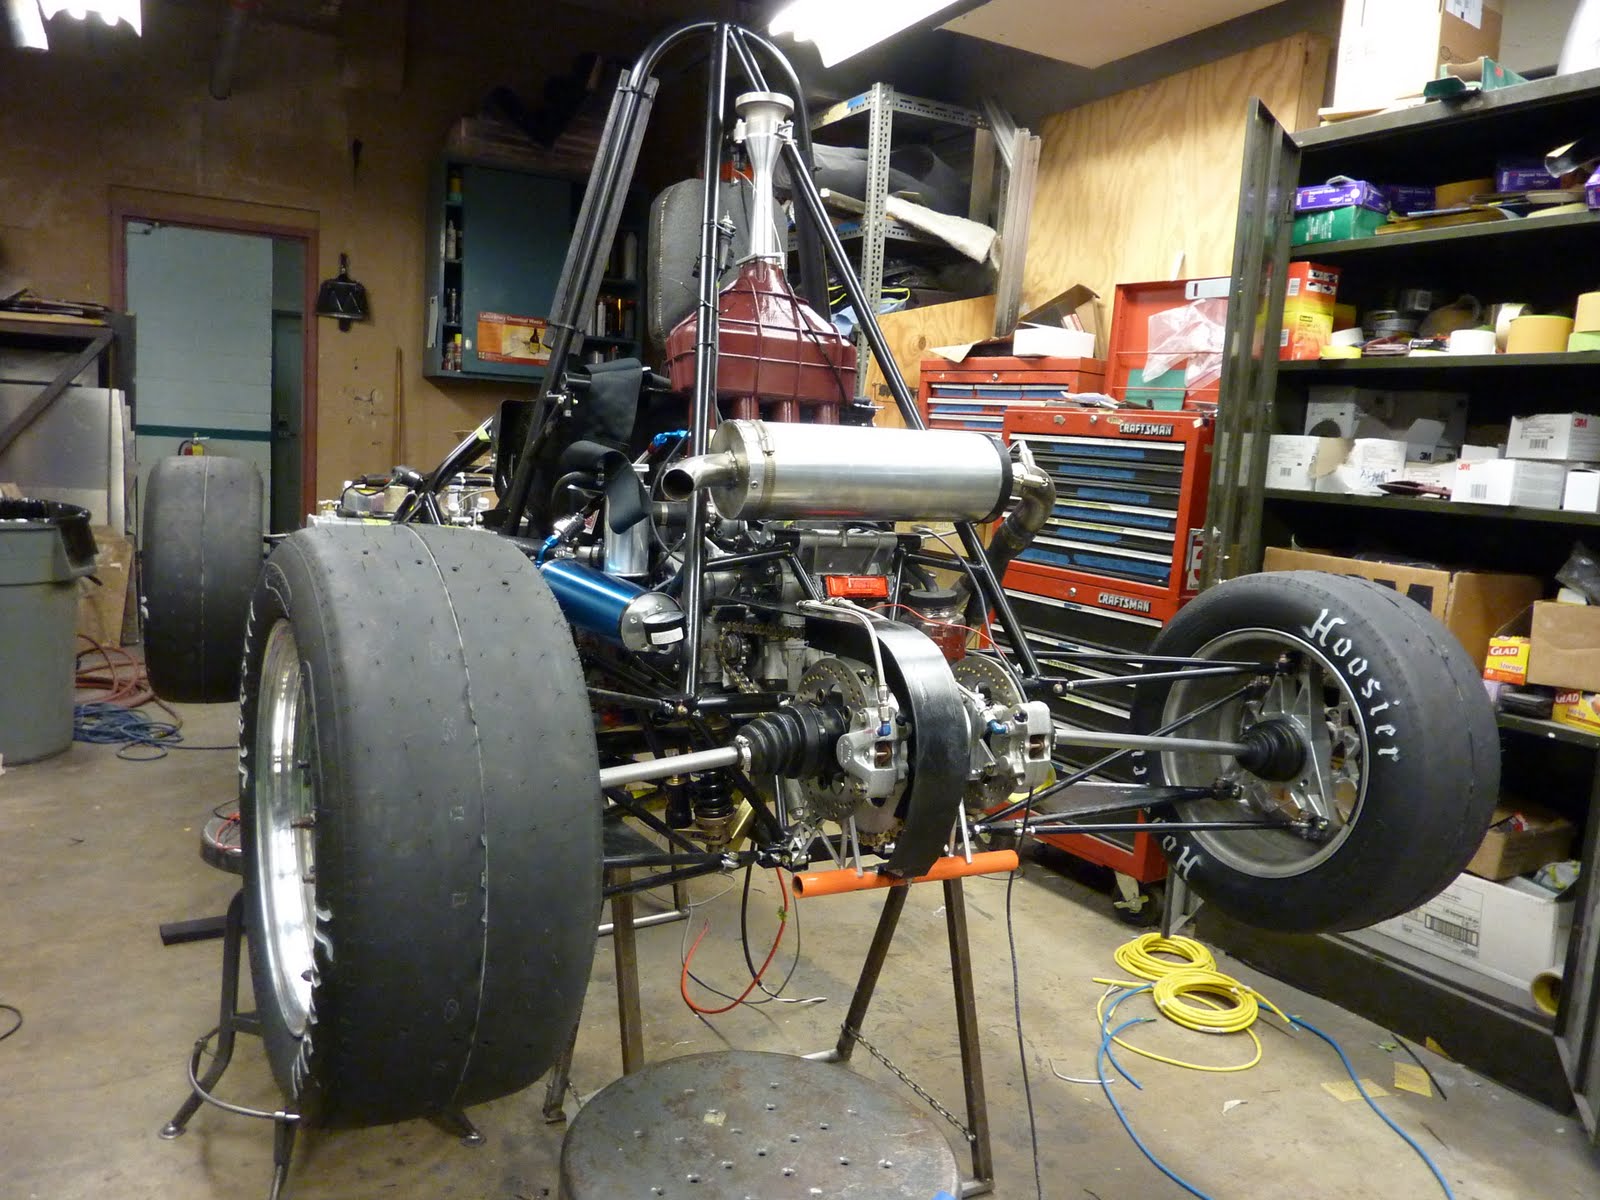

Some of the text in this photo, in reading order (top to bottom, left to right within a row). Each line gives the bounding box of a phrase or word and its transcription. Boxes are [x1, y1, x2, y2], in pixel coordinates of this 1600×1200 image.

[1574, 418, 1587, 428] 3M
[1120, 423, 1173, 436] CRAFTSMAN
[1419, 451, 1432, 461] 3M
[1458, 463, 1470, 471] 3M
[1098, 592, 1151, 613] CRAFTSMAN
[1490, 646, 1518, 656] GLAD
[1500, 661, 1524, 673] Storage
[1302, 608, 1400, 762] Hoosier
[1555, 692, 1580, 704] GLAD
